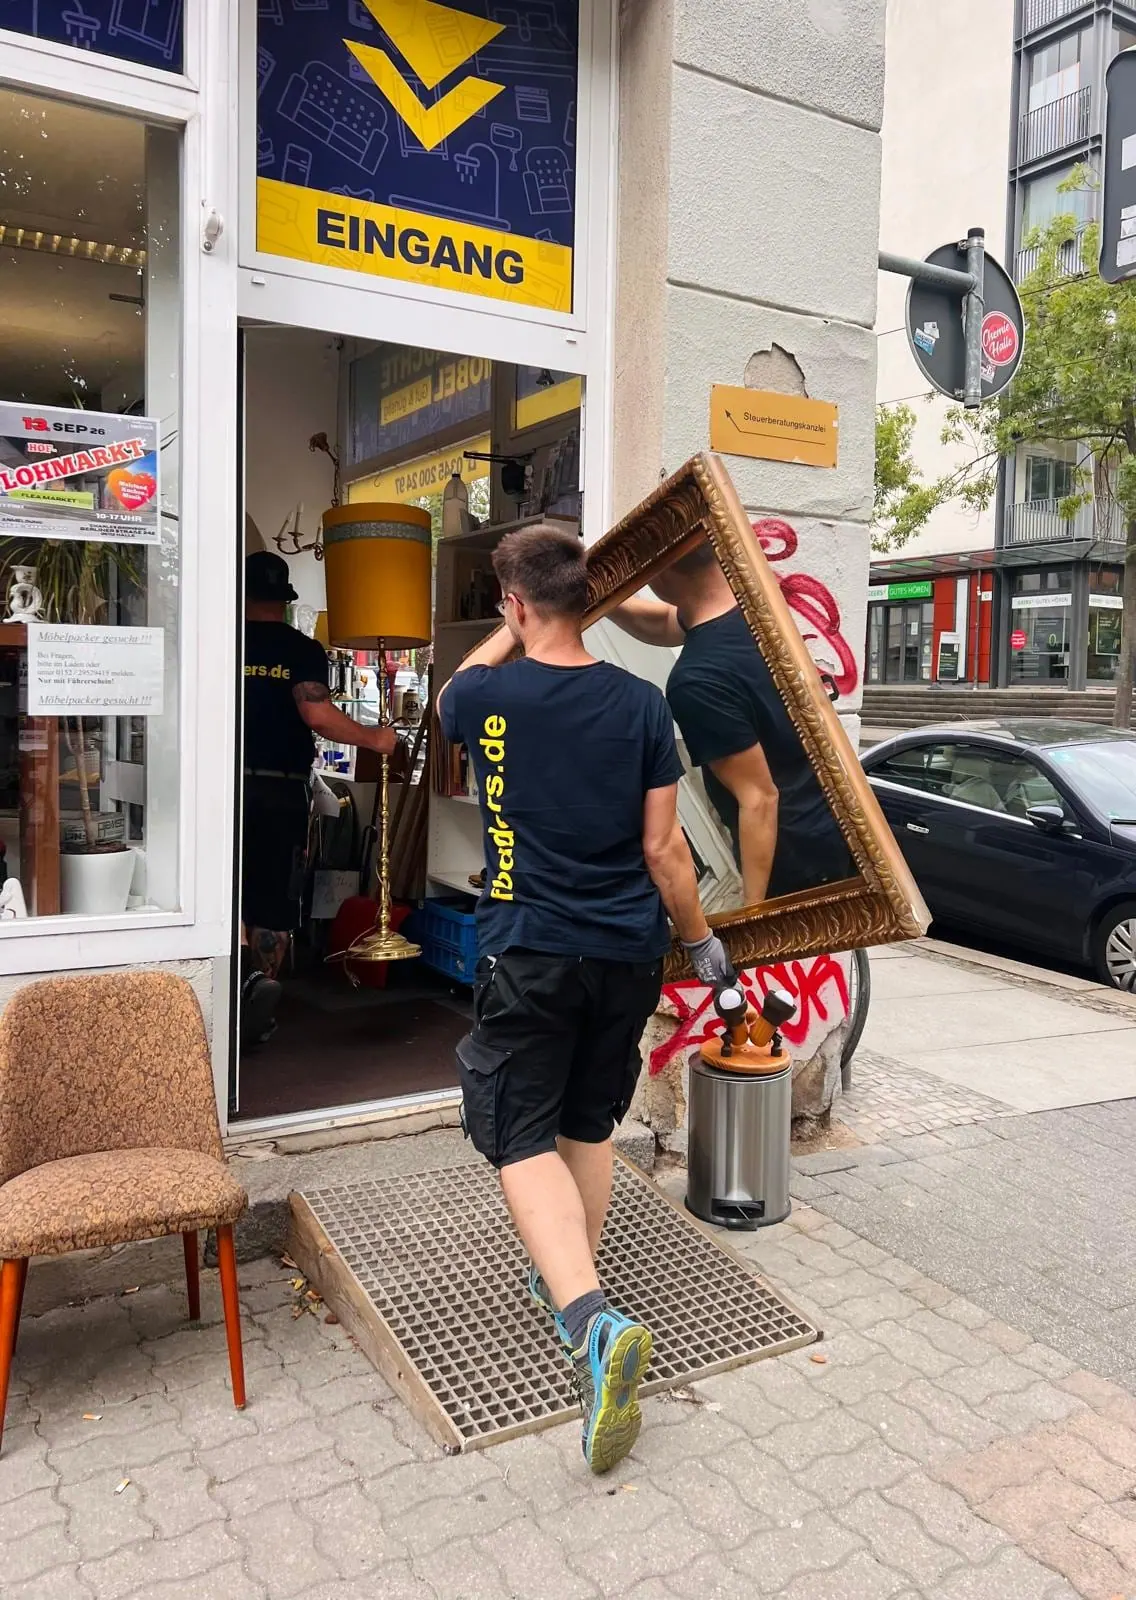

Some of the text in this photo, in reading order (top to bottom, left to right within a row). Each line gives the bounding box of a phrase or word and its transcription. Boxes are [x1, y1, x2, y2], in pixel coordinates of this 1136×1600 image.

[317, 208, 524, 284] EINGANG
[982, 320, 1009, 347] Chemie
[988, 335, 1012, 358] Halle
[53, 422, 88, 434] SEP
[90, 427, 105, 435] 26
[743, 412, 826, 433] Steuerberatungskanzlei
[43, 495, 77, 503] MARKET
[889, 587, 906, 596] GUTES
[908, 585, 929, 595] HÖREN
[38, 631, 99, 644] Möbelpacker
[102, 633, 138, 644] gesucht
[38, 695, 100, 706] Möbelpacker
[102, 695, 139, 706] gesucht
